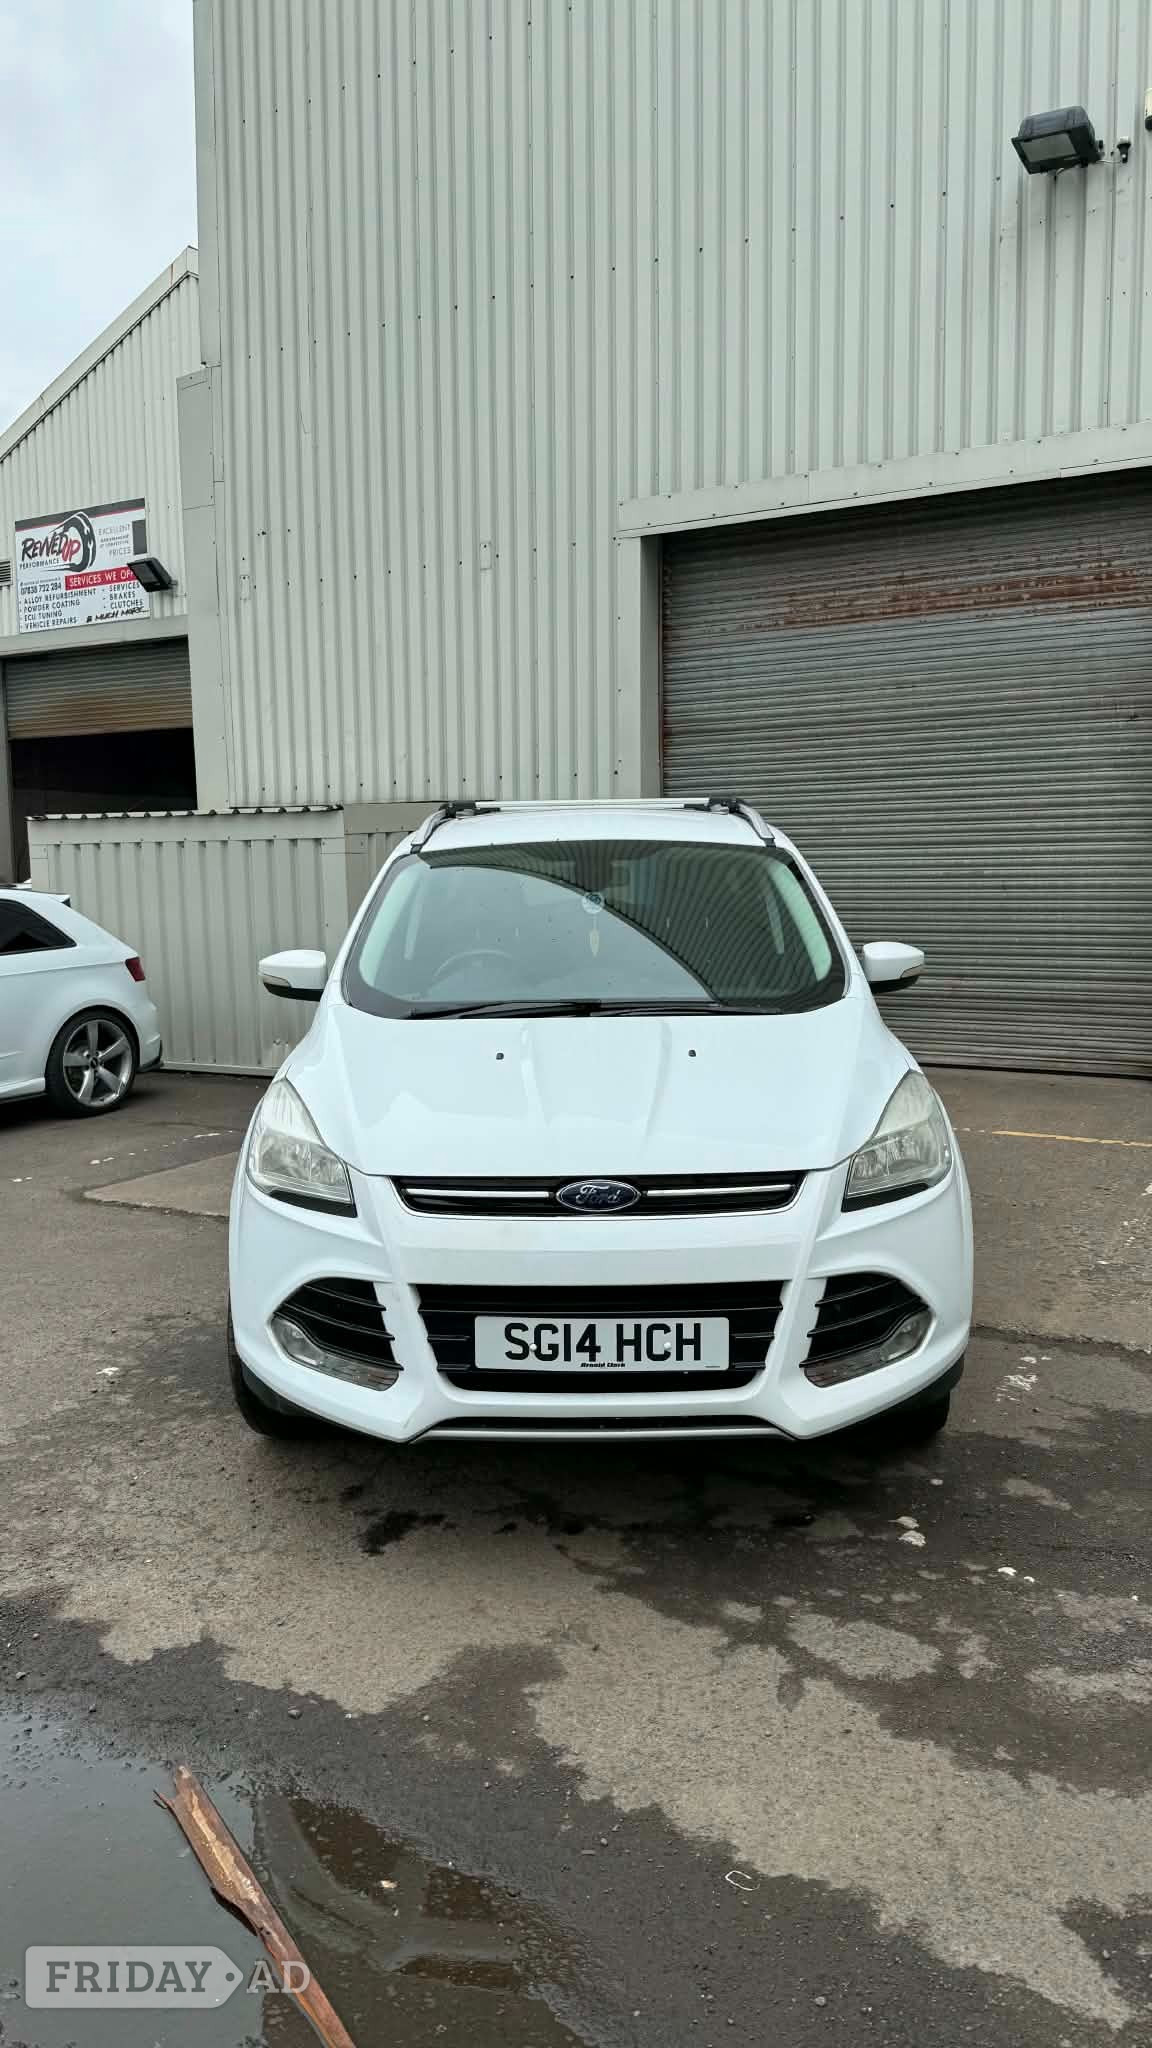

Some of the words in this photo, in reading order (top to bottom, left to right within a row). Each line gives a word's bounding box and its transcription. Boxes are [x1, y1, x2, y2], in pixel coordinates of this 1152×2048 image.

[62, 538, 81, 562] UP
[19, 559, 59, 569] PERFORMANCE
[69, 573, 102, 587] SERVICES
[105, 571, 117, 581] WE
[109, 582, 140, 592] SERVICES
[24, 596, 42, 604] ALLOY
[45, 588, 97, 601] REFURBISHMENT
[110, 591, 136, 601] BRAKES
[24, 603, 50, 614] POWDER
[52, 599, 81, 609] COATING
[110, 599, 143, 610] CLUTCHES
[24, 614, 36, 622] ECU
[38, 610, 63, 619] TUNING
[25, 620, 50, 630] VEHICLE
[52, 616, 77, 626] REPAIRS
[575, 1184, 622, 1205] Ford
[504, 1322, 602, 1362] SG14
[616, 1322, 702, 1362] HCH
